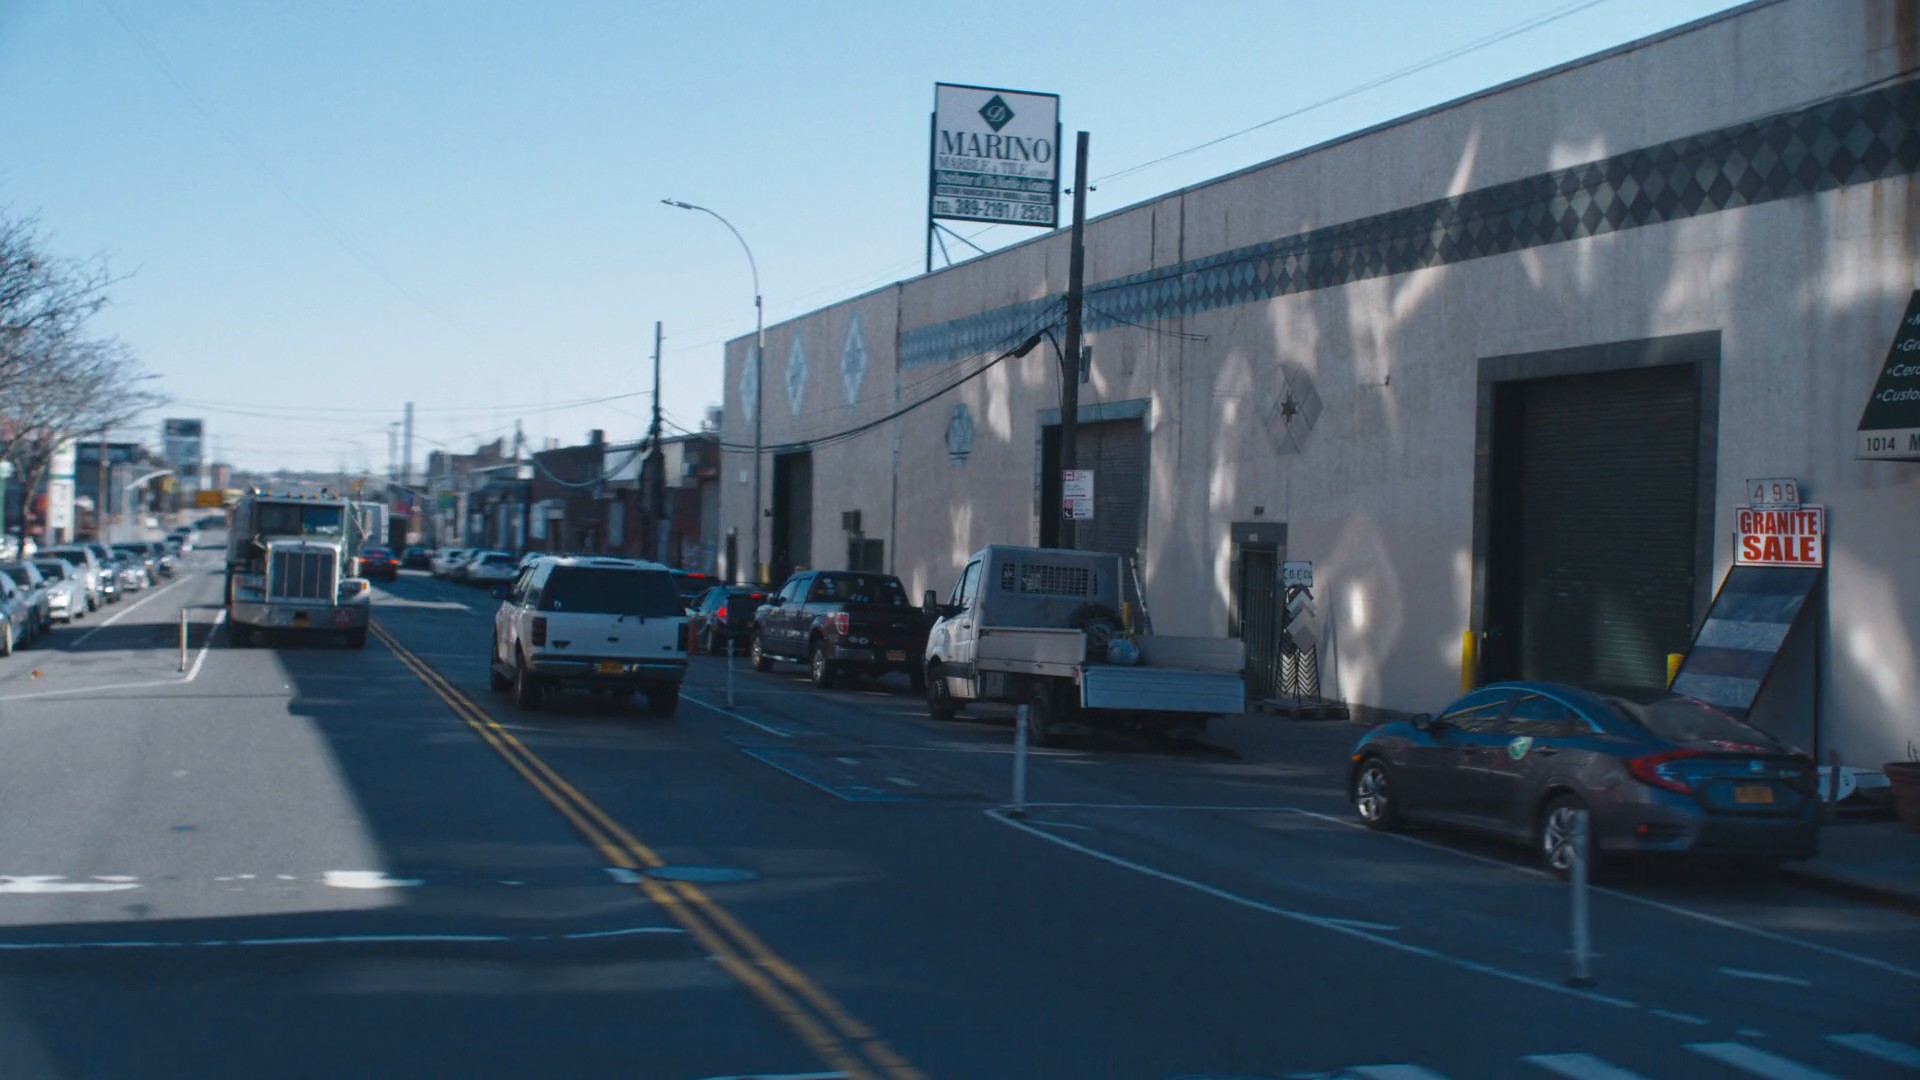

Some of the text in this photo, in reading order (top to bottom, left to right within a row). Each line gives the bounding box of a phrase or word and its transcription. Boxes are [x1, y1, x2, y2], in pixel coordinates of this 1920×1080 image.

[940, 130, 1051, 163] MARINO
[1867, 437, 1895, 452] 1014
[1740, 511, 1818, 535] GRANITE
[1742, 535, 1816, 561] SALE
